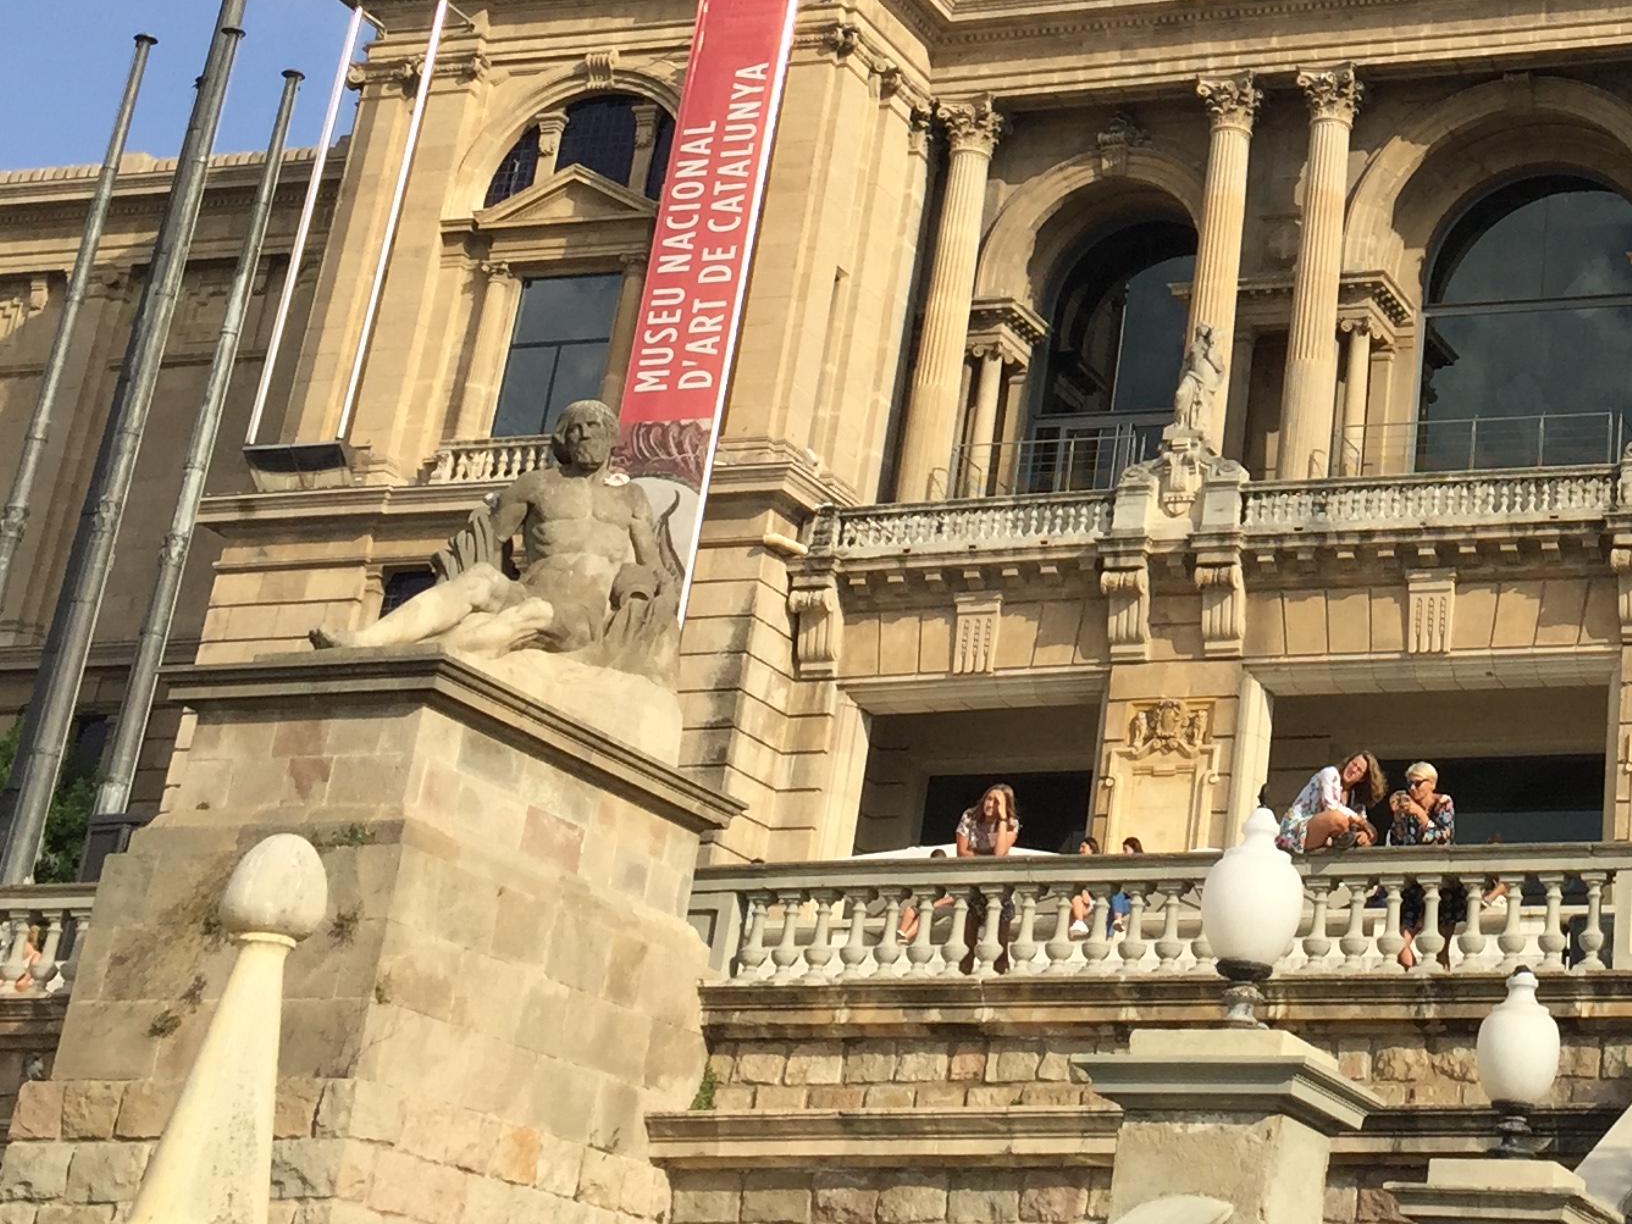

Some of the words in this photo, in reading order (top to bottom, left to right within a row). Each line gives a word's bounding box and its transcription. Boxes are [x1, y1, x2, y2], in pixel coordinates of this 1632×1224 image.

[656, 120, 717, 274] NACIONAL
[706, 62, 771, 233] CATALUNYA
[697, 244, 738, 284] DE
[633, 287, 686, 393] MUSEU
[677, 298, 729, 390] D'ART
